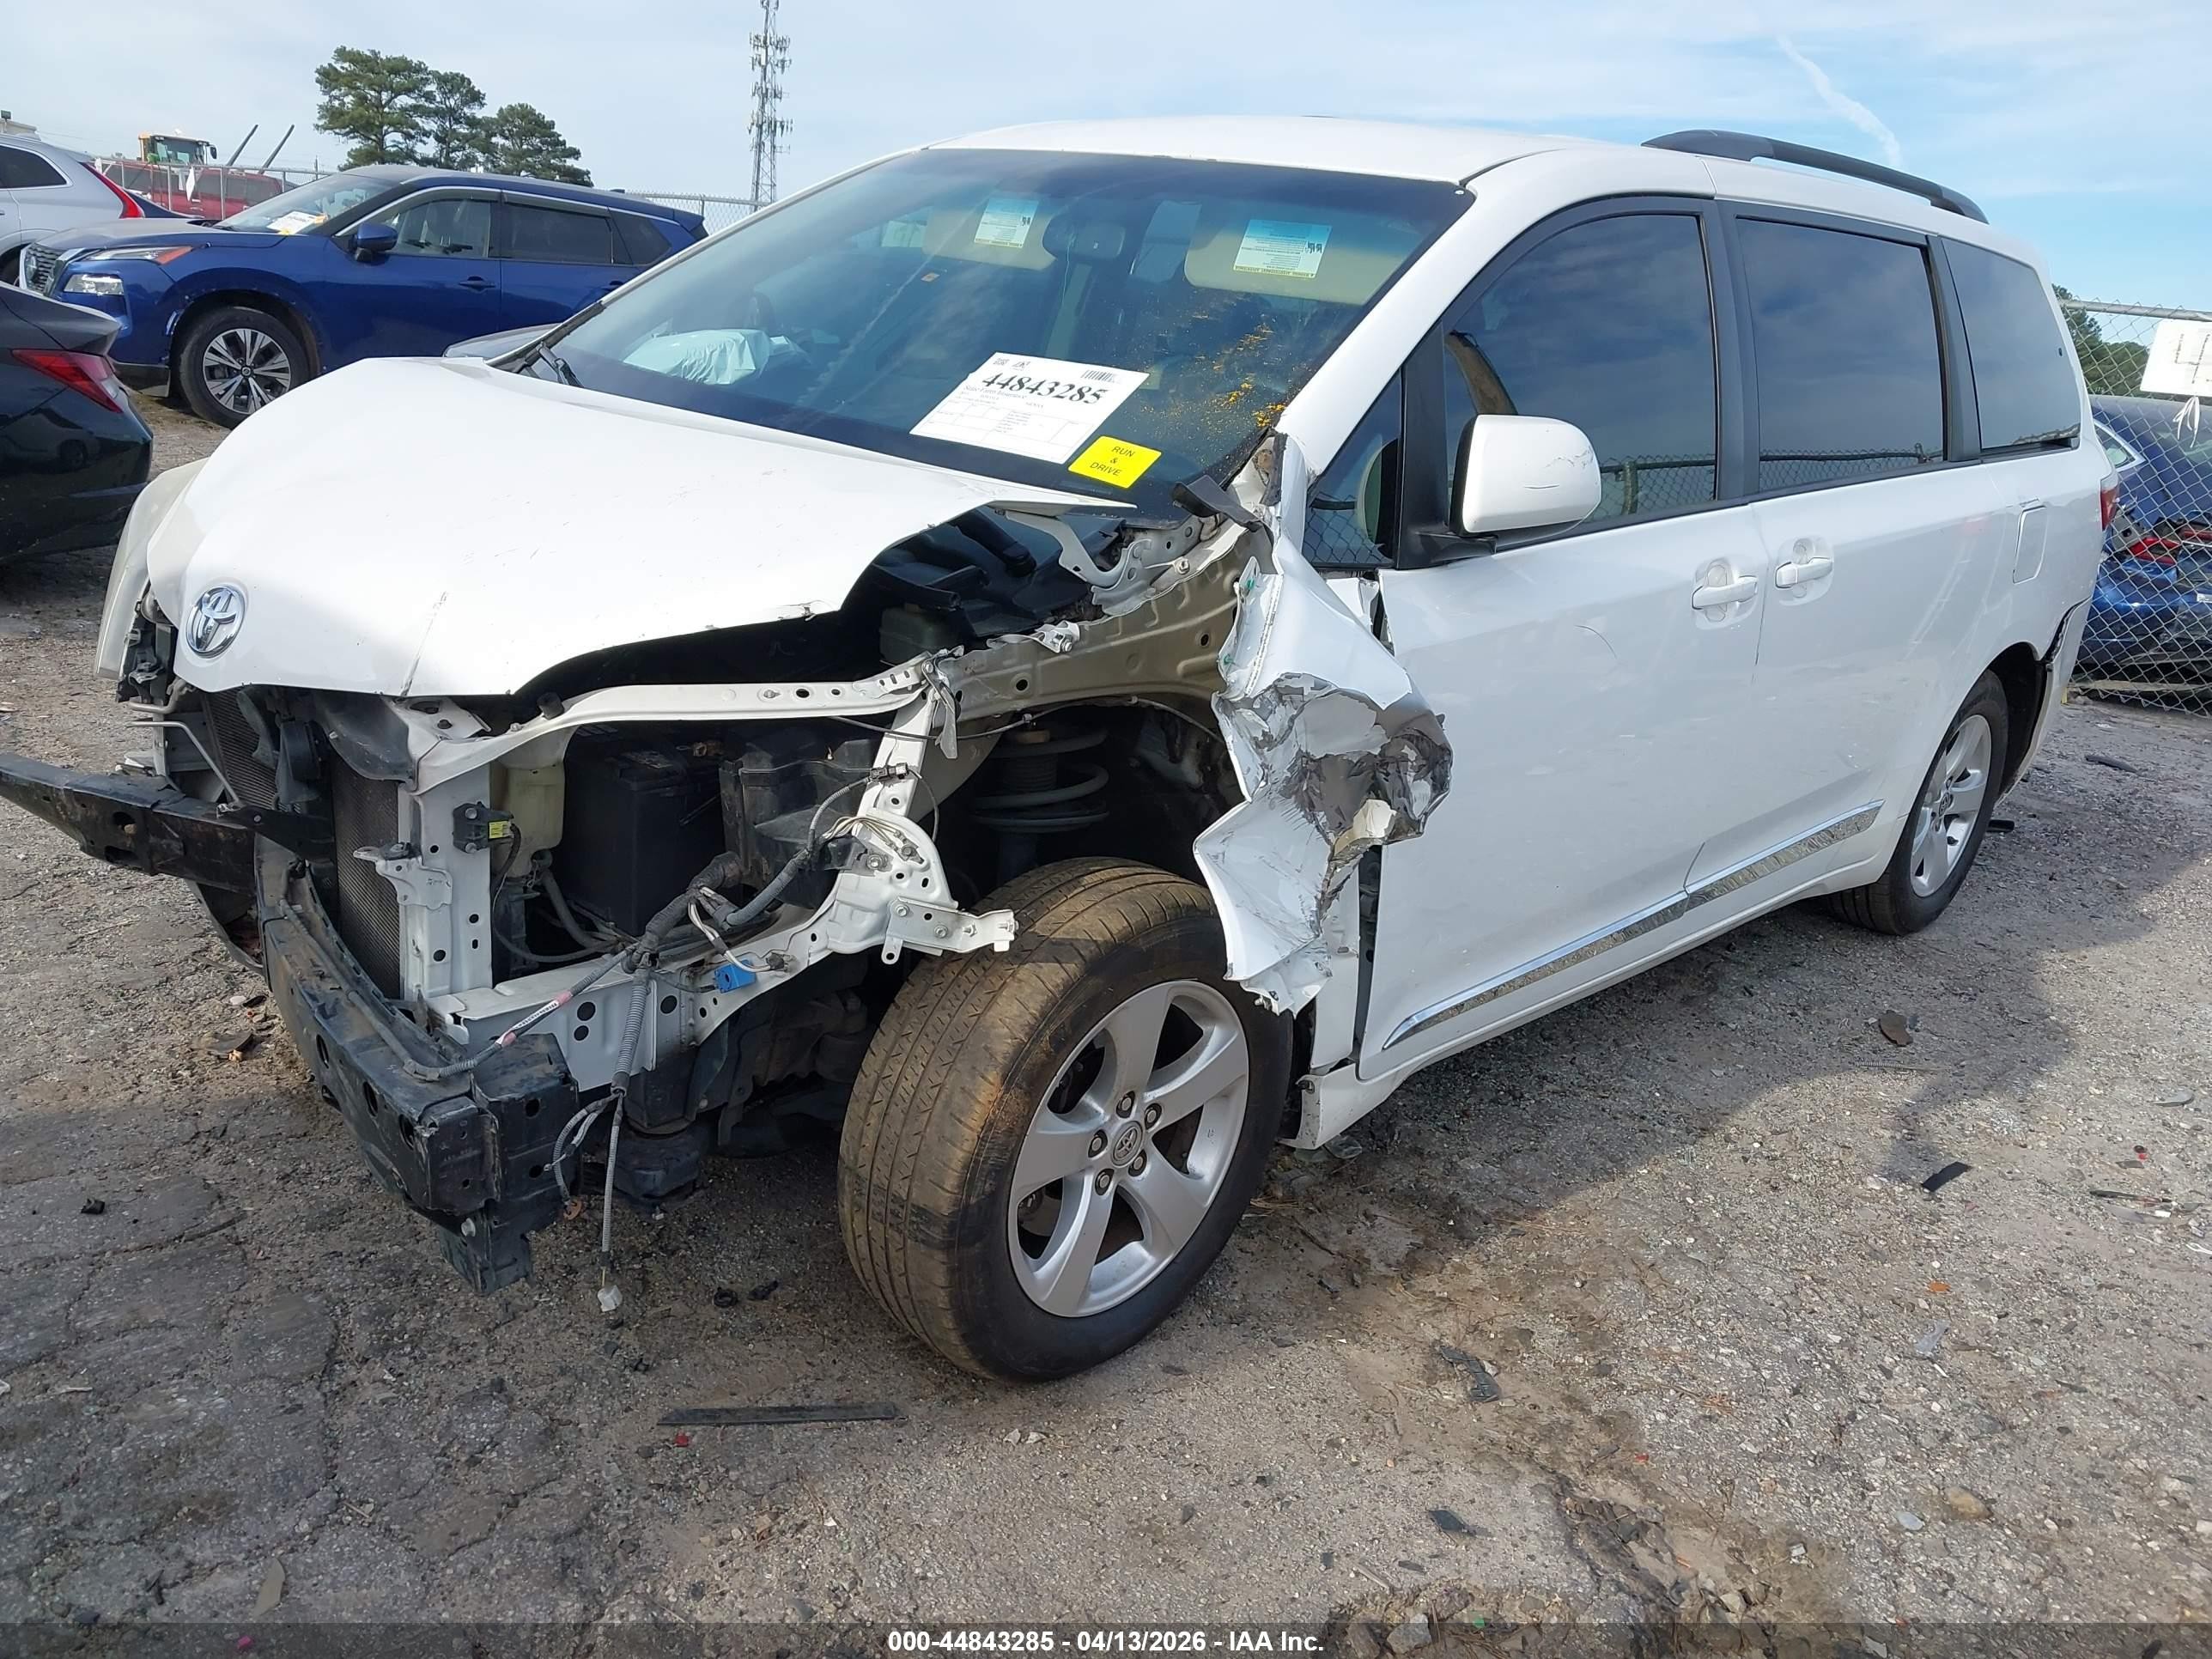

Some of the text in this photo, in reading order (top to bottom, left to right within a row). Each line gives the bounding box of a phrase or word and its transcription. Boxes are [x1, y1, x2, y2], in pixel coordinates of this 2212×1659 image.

[982, 372, 1109, 404] 44843285
[1111, 446, 1135, 458] RUN
[1090, 462, 1122, 477] DRIVE
